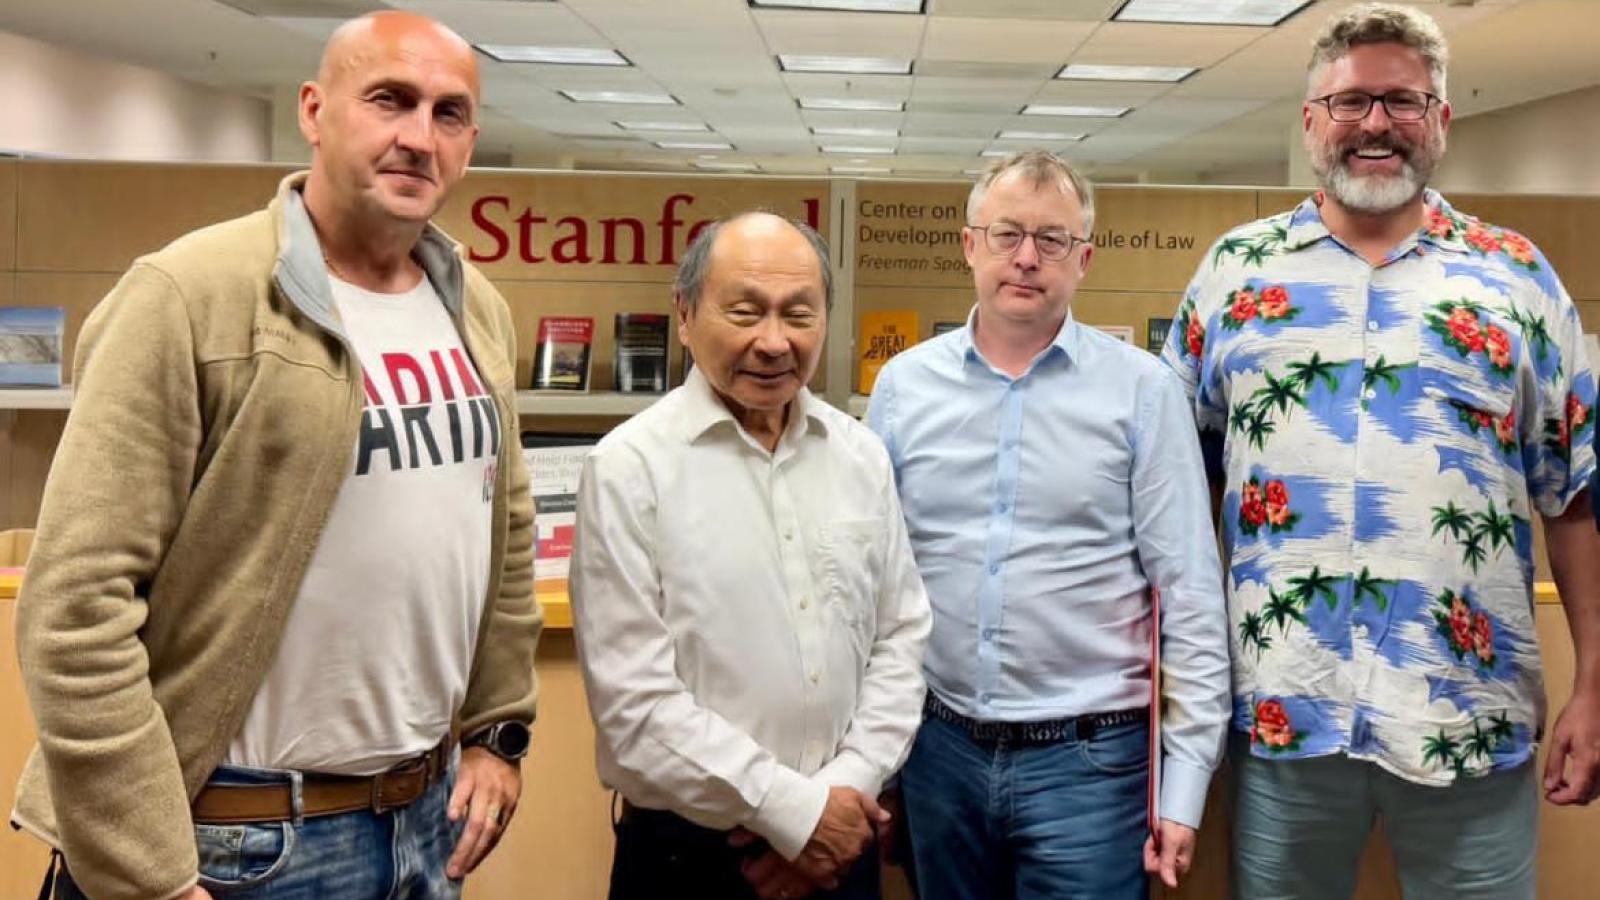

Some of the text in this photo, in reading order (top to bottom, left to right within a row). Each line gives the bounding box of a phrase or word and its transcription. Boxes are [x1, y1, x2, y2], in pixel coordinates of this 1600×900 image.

[860, 199, 957, 219] Center on
[468, 193, 820, 266] Stanf
[860, 225, 1195, 249] Developm ule of Law
[859, 254, 972, 275] Freeman Spog
